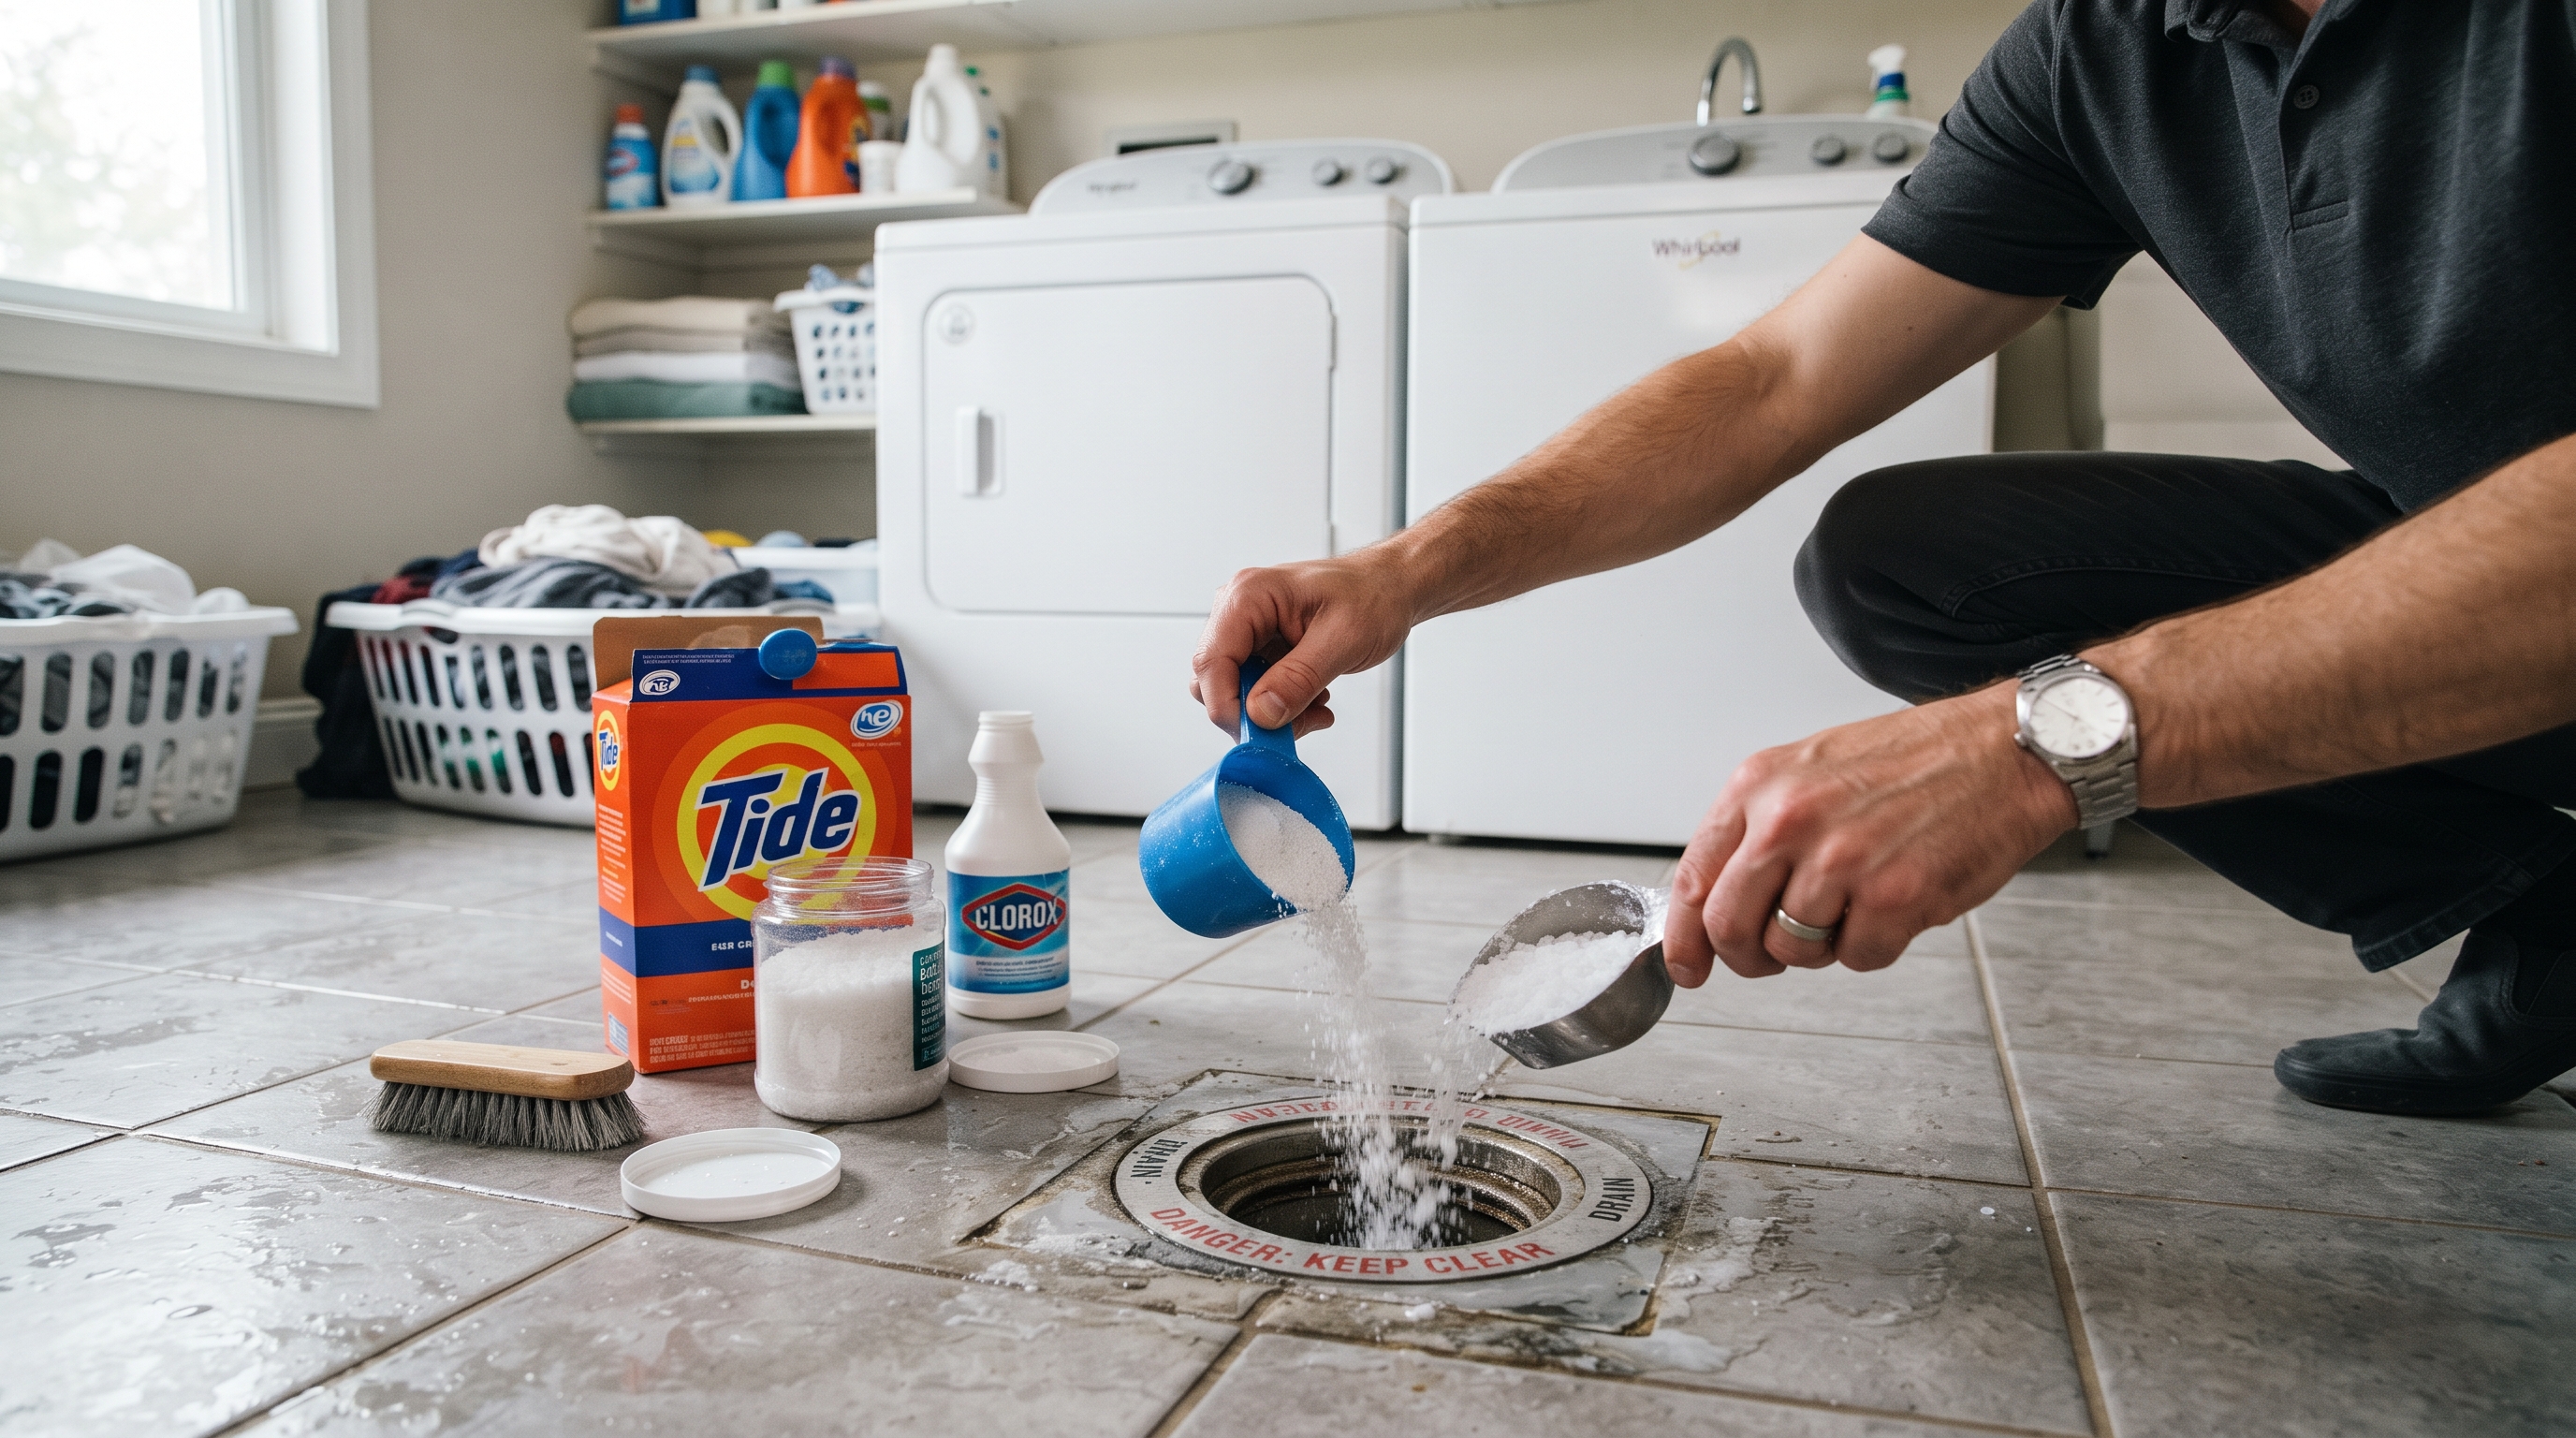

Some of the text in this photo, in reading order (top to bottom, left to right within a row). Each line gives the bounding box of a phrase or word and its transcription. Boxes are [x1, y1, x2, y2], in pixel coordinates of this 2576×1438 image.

[695, 767, 861, 891] Tide
[974, 898, 1058, 931] CLOROX
[1588, 1178, 1635, 1223] DRAIN
[1150, 1207, 1557, 1275] DANGER: KEEP CLEAR
